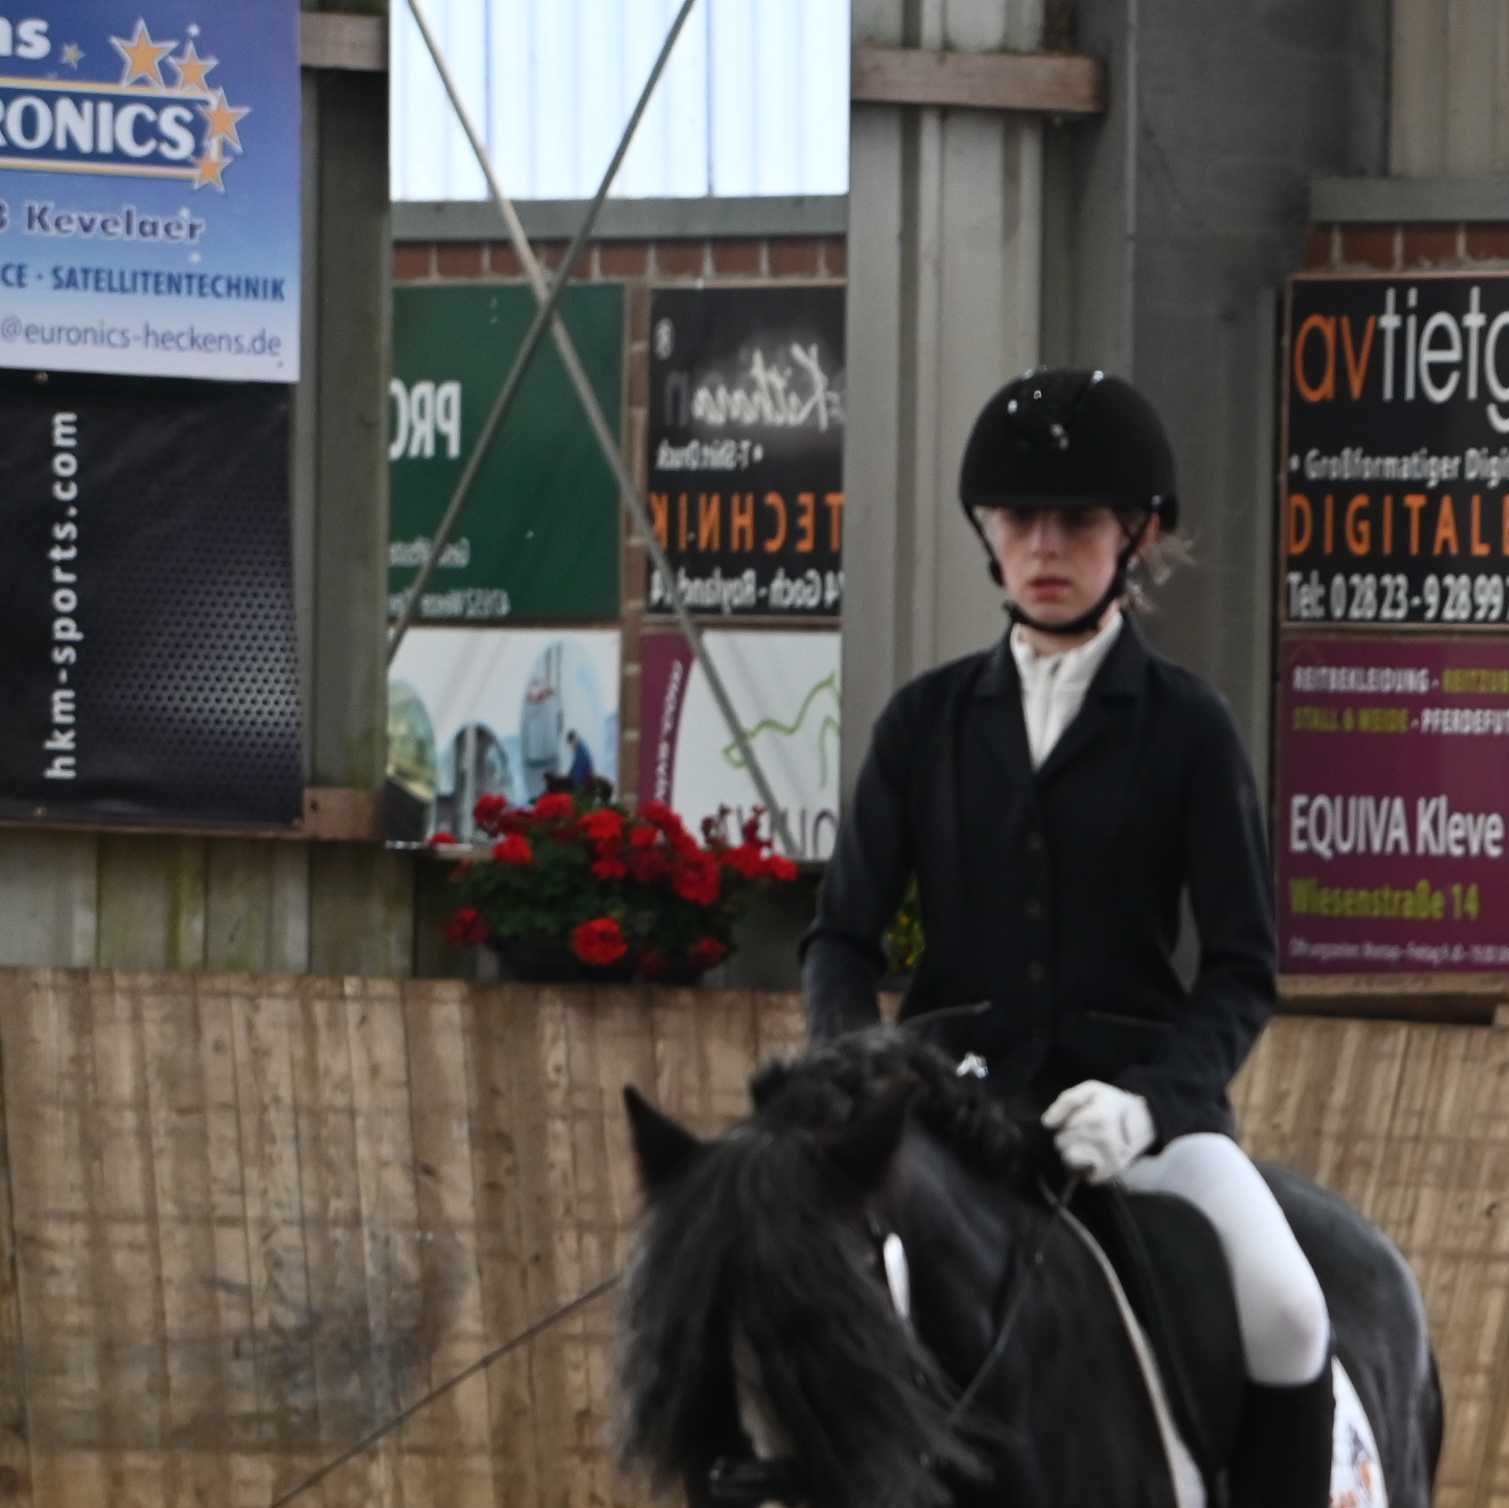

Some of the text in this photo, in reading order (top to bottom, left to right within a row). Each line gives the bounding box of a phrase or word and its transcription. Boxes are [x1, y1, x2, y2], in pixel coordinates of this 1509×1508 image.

[25, 200, 204, 242] Kevelaer
[52, 264, 286, 301] SATELLITENTECHNIK
[44, 411, 84, 780] hkm-sports.com
[1290, 793, 1504, 860] EQUIVA Kleve
[1452, 882, 1480, 920] 14
